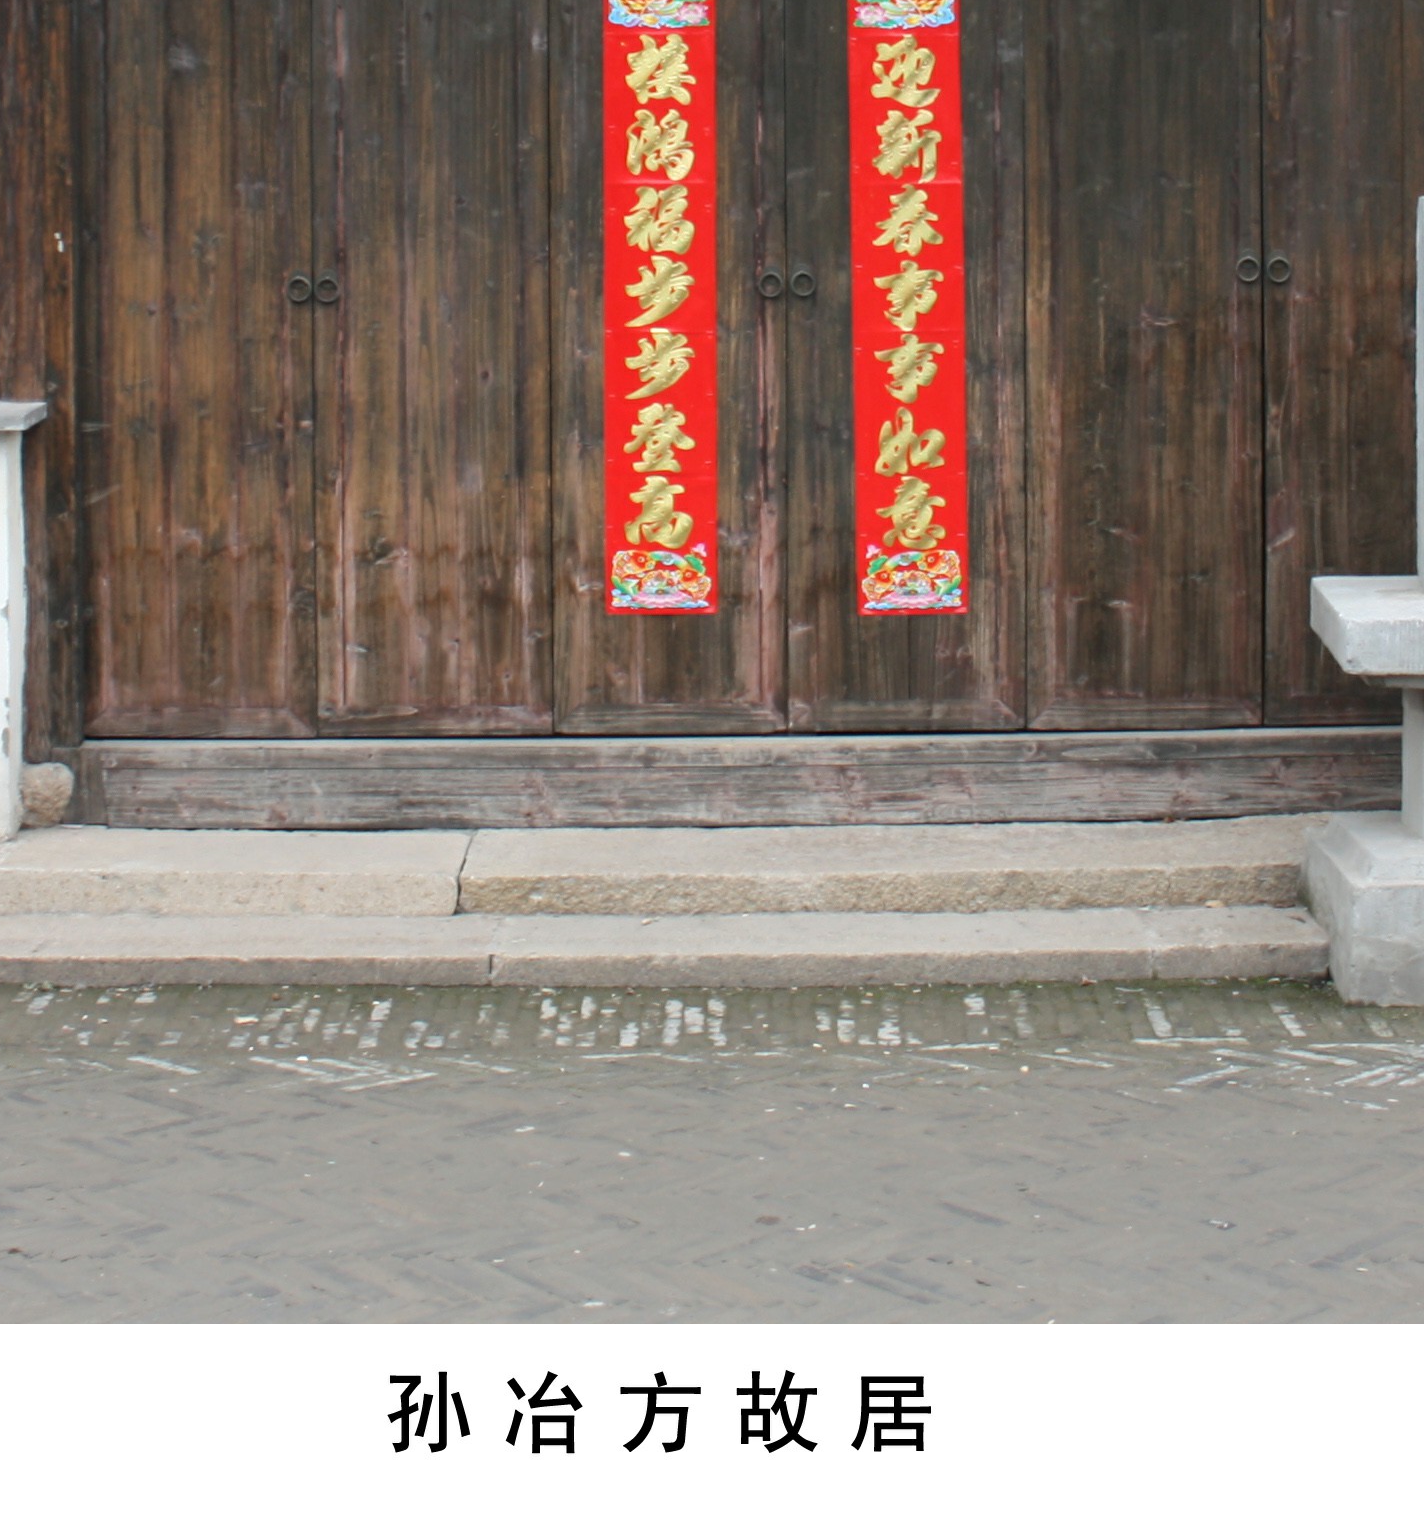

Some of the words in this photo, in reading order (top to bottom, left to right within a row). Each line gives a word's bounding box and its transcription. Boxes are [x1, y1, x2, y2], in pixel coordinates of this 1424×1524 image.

[622, 32, 697, 549] 接鸿福步步登高
[870, 33, 948, 551] 迎新春事事如意
